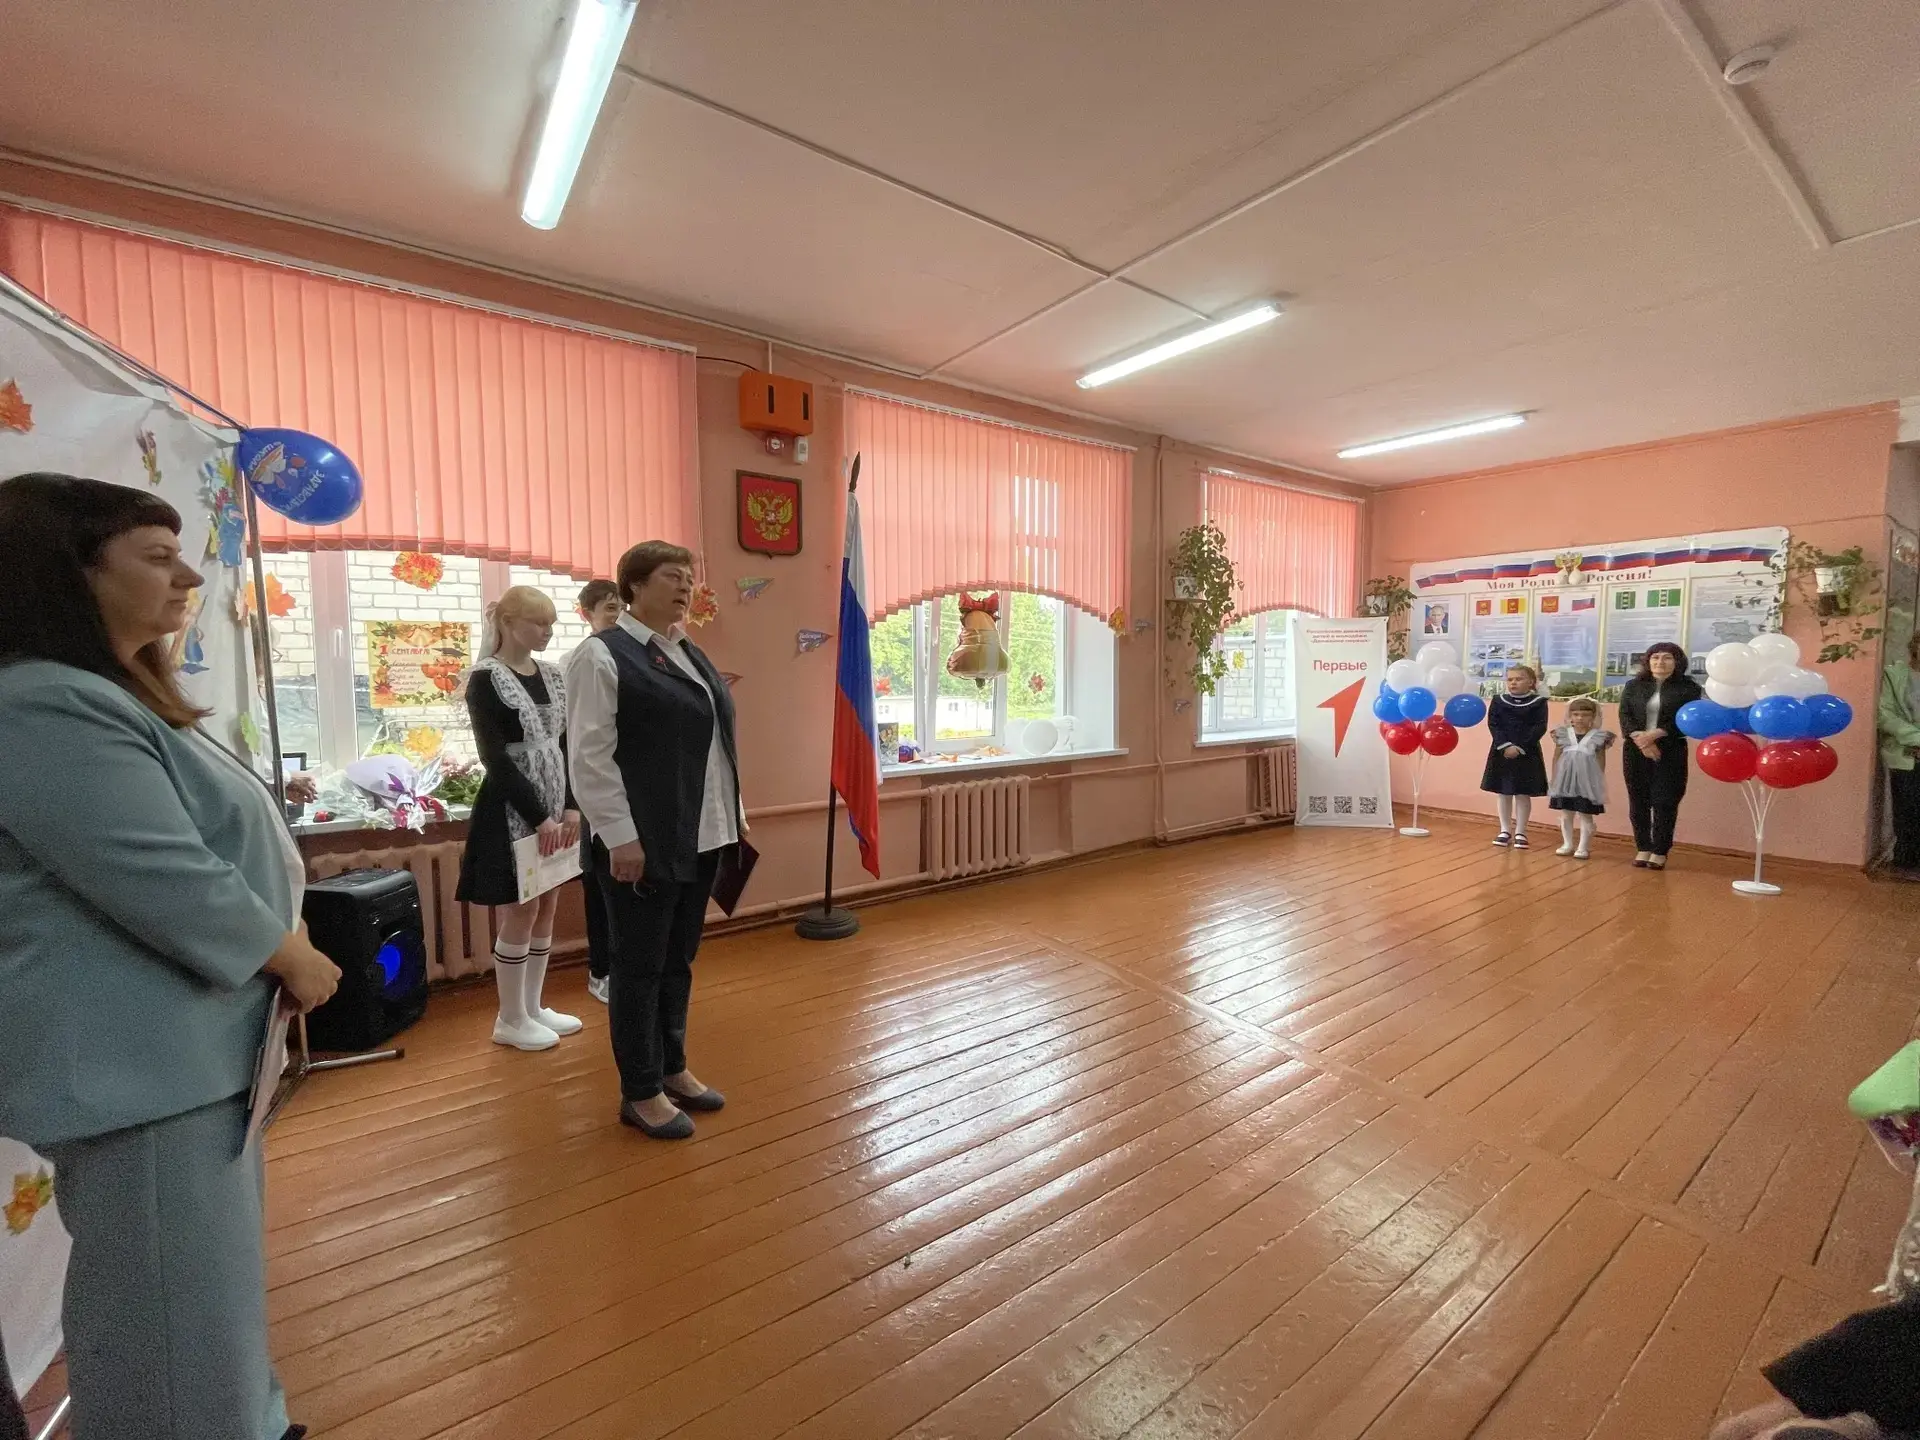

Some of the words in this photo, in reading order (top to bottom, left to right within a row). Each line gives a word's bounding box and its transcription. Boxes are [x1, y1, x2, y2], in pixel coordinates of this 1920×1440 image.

[1487, 581, 1514, 590] Моя
[1521, 579, 1555, 588] Роди
[1586, 569, 1652, 584] Россия!
[1313, 660, 1368, 674] Первые
